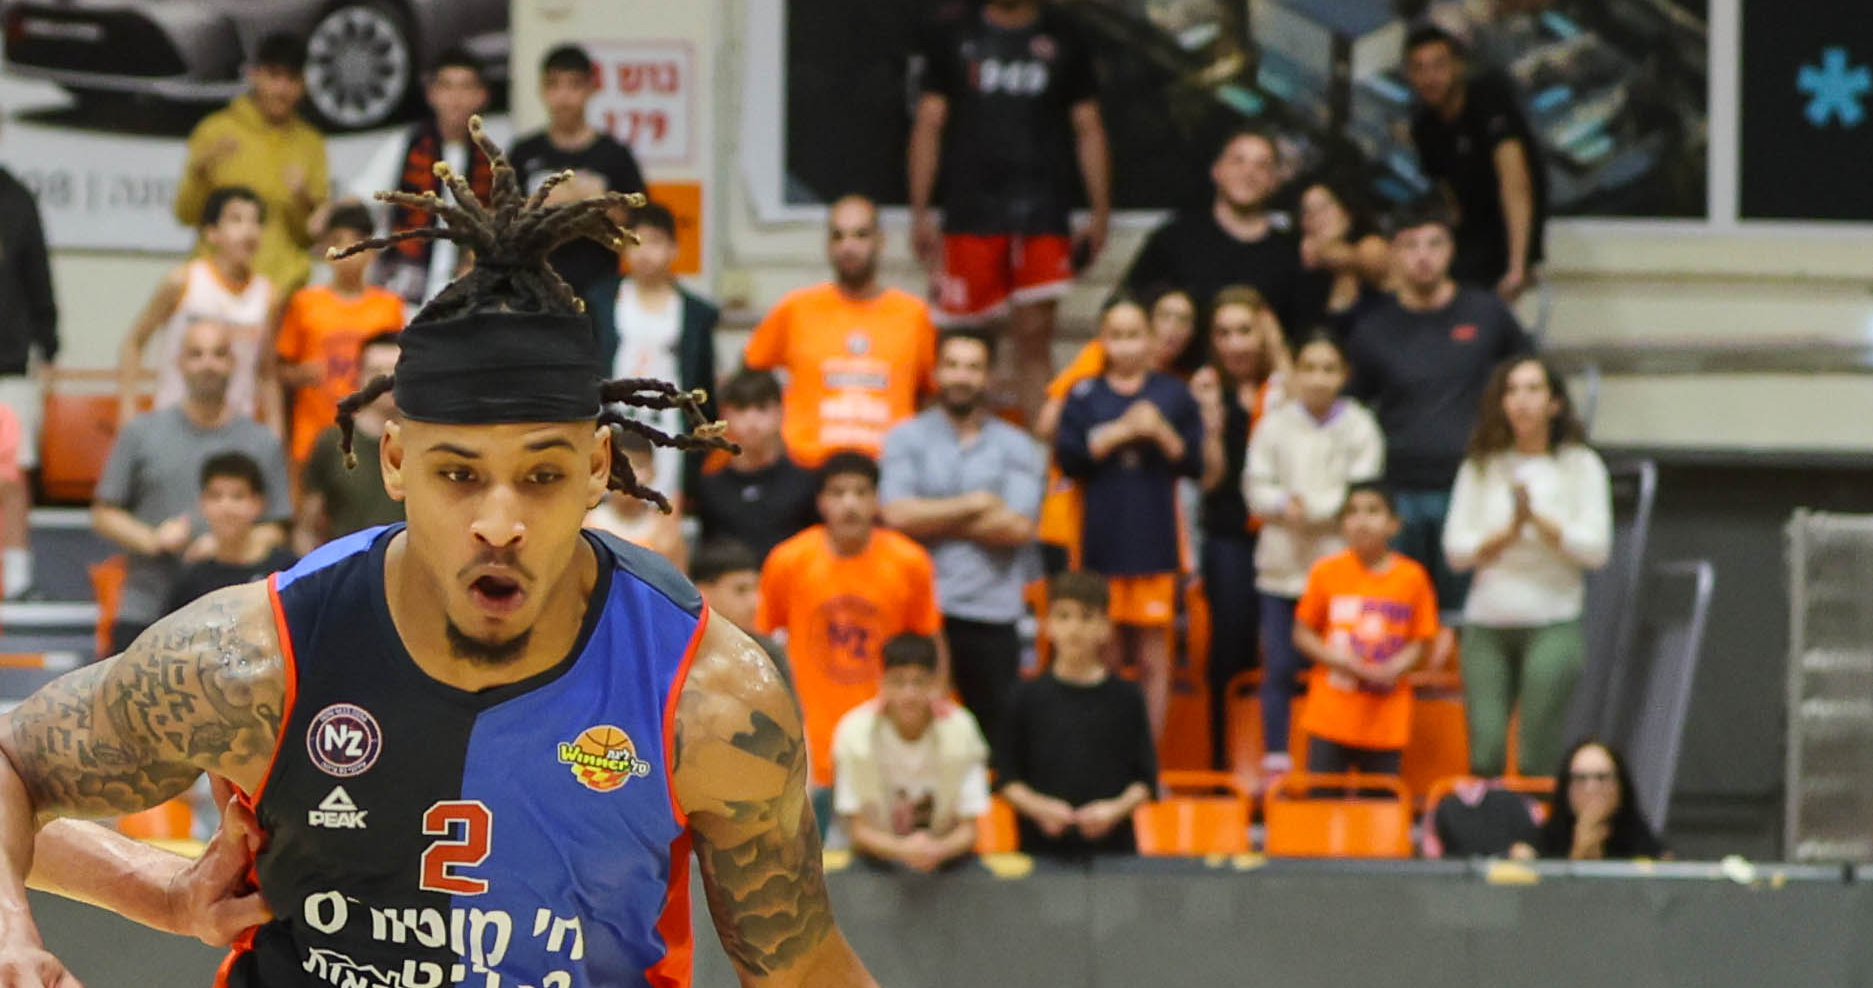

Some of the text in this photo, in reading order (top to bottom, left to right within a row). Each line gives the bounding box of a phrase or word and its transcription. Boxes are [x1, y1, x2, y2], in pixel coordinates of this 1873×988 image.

[324, 724, 363, 756] NZ
[560, 745, 630, 771] Winner
[308, 809, 368, 829] PEAK
[419, 800, 492, 895] 2
